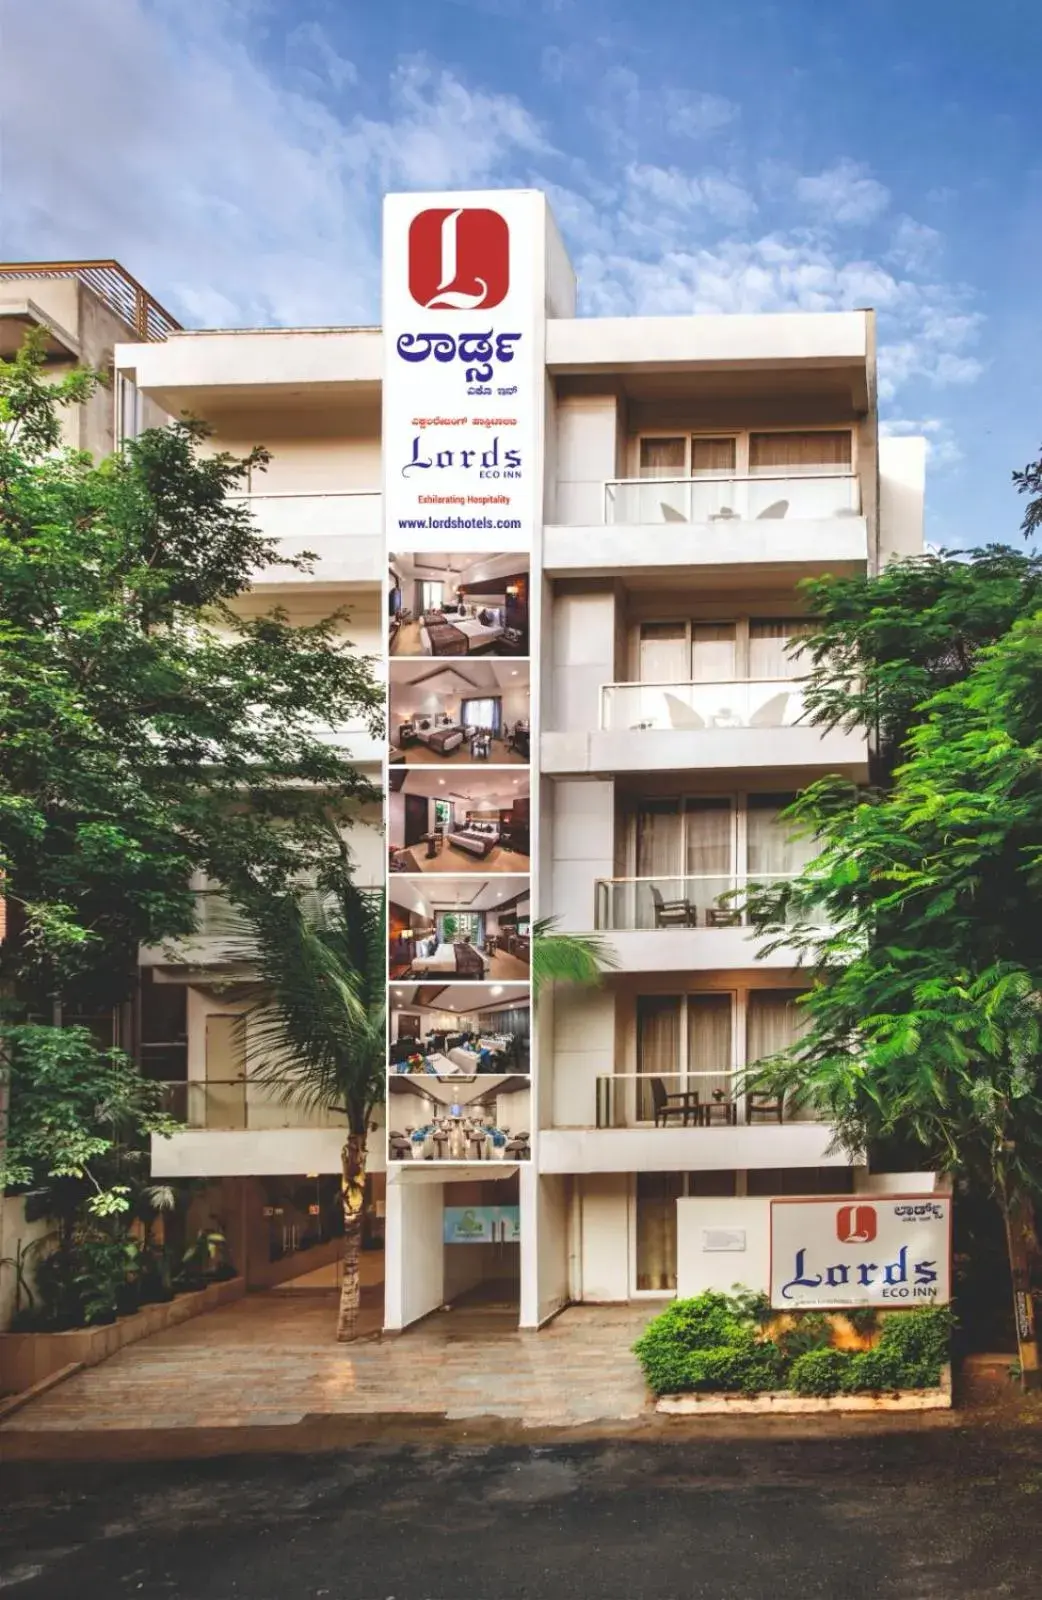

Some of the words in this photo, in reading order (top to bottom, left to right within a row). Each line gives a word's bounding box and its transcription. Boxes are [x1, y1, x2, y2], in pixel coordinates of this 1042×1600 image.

[424, 208, 488, 310] L
[402, 436, 522, 479] Lords
[480, 470, 501, 479] ECO
[503, 470, 522, 479] INN
[467, 495, 511, 506] Hospitality
[398, 516, 522, 529] www.lordshotels.com
[844, 1207, 869, 1243] L
[782, 1246, 937, 1299] Lords
[882, 1288, 909, 1298] ECO
[913, 1288, 937, 1297] INN
